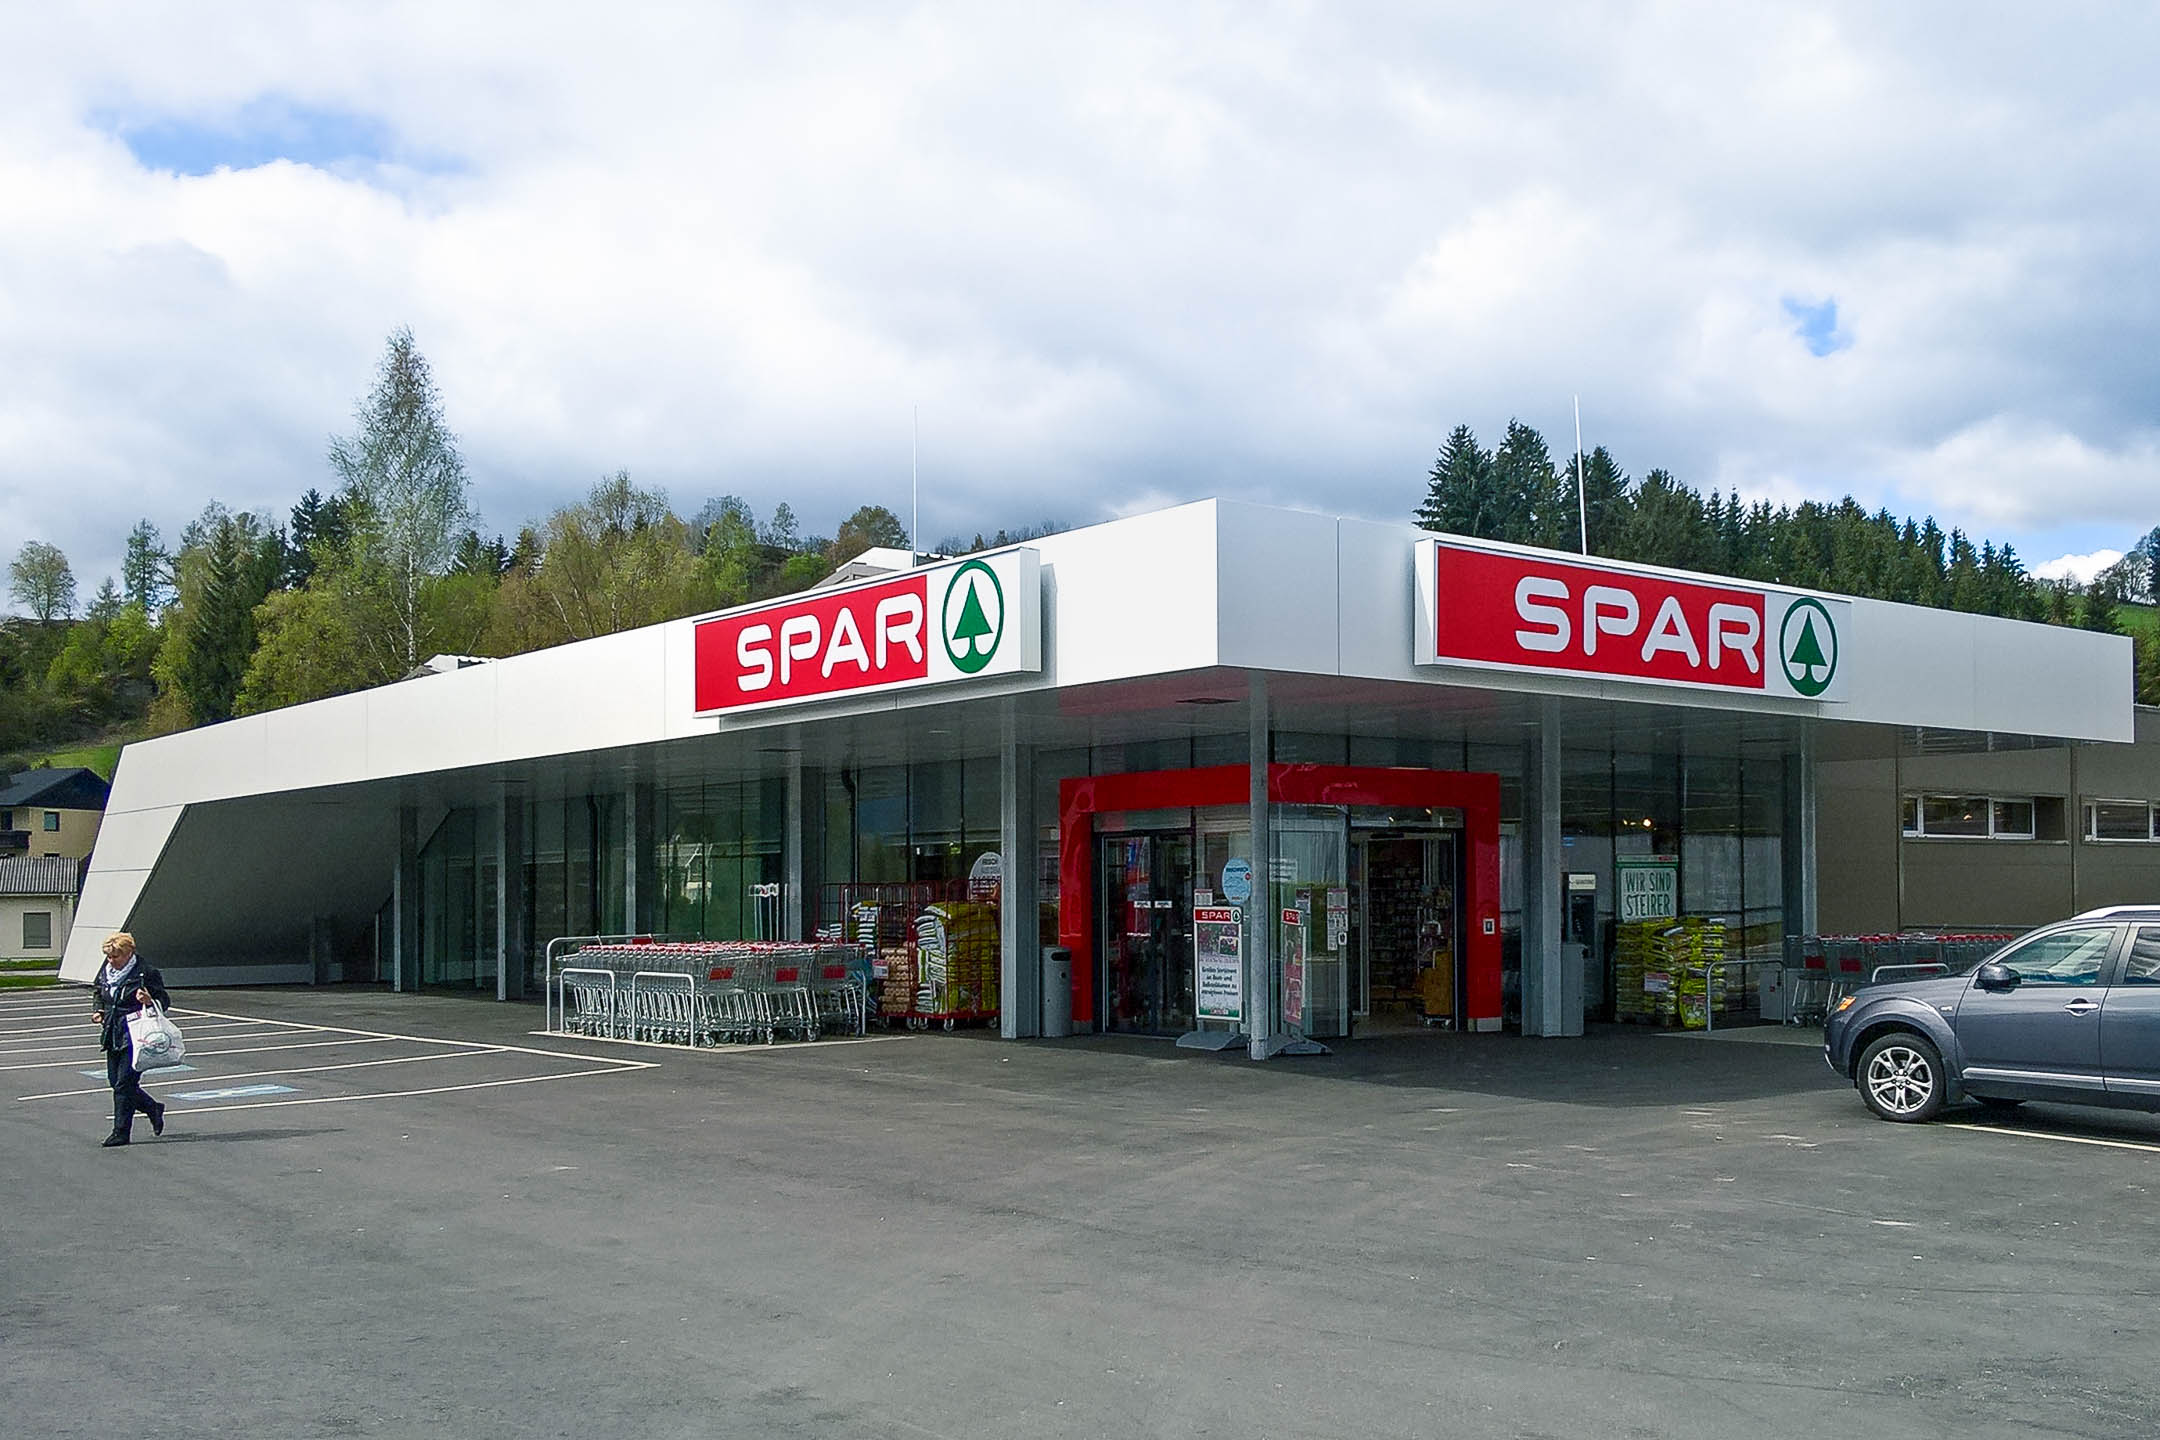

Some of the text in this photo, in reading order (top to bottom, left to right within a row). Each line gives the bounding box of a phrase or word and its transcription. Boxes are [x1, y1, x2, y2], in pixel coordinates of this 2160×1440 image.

[1514, 575, 1761, 674] SPAR
[736, 592, 924, 692] SPAR
[1625, 872, 1672, 892] WIR SIND
[1201, 911, 1231, 920] SPAR
[1626, 893, 1671, 916] STEIRER
